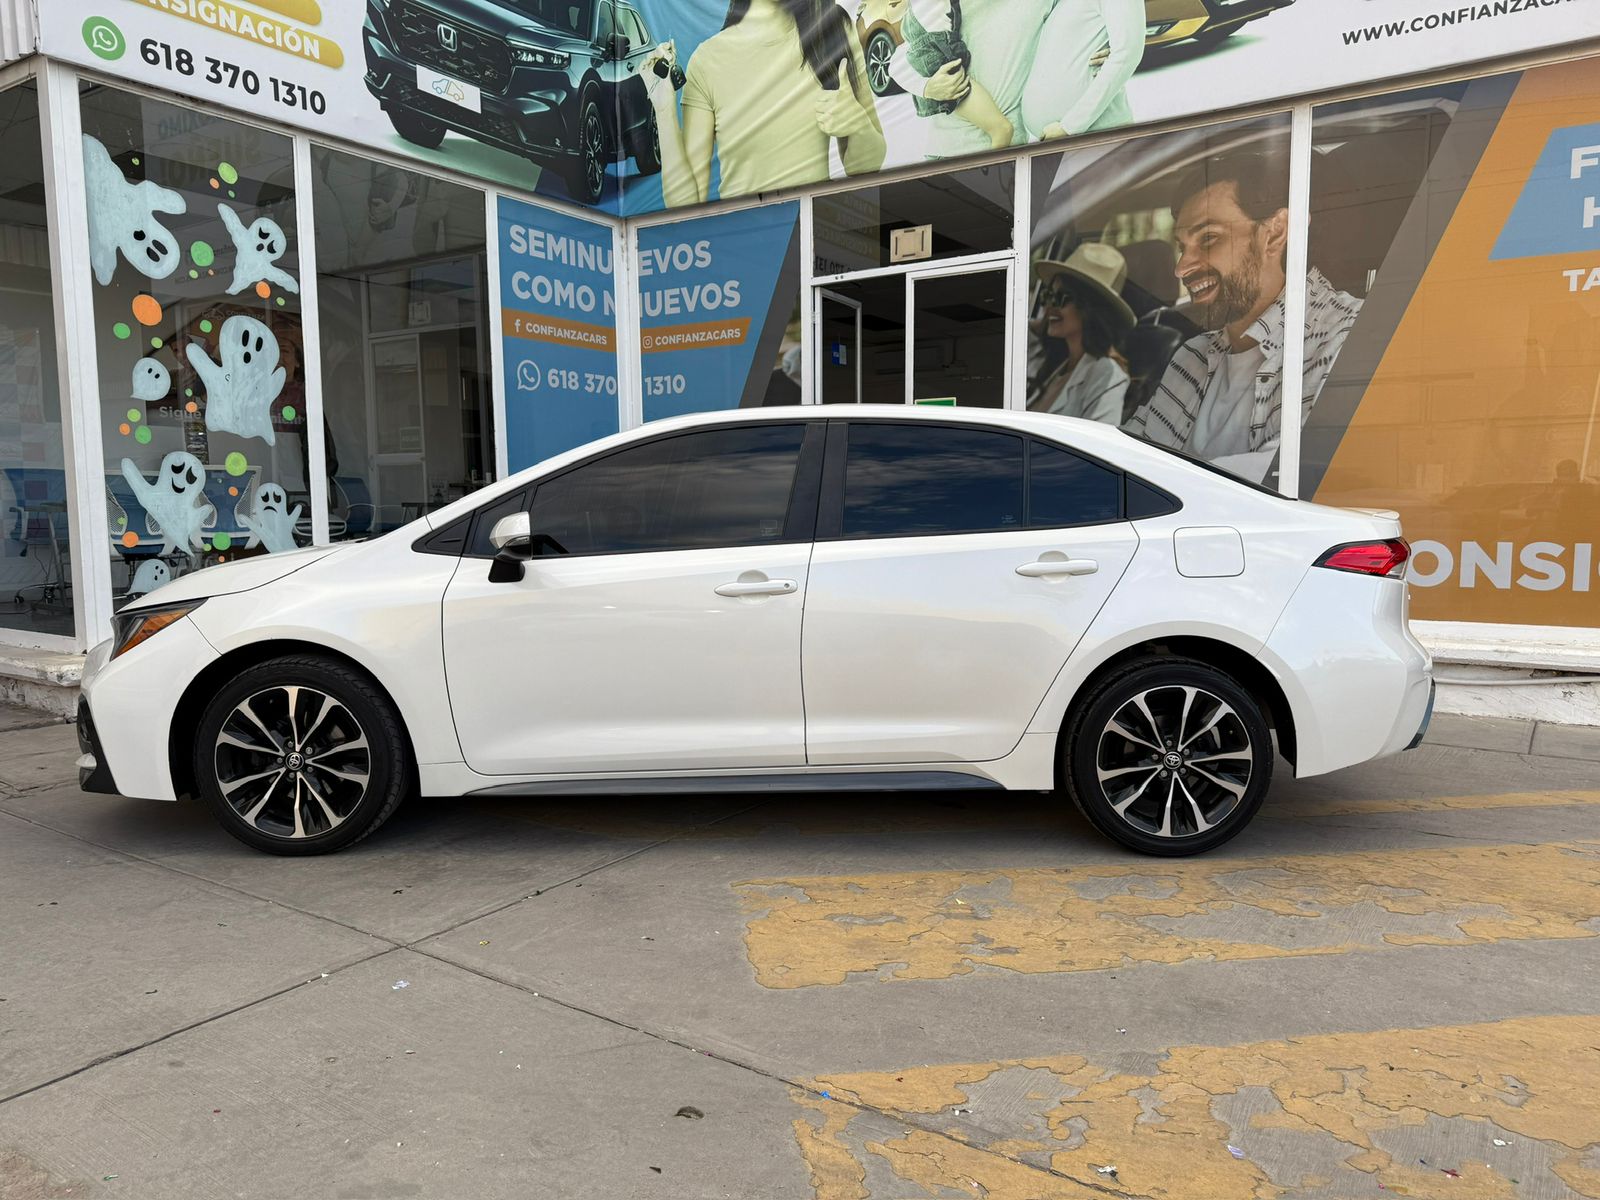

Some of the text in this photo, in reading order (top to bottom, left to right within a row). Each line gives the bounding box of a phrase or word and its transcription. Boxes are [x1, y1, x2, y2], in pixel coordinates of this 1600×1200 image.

[149, 0, 320, 59] SIGNACIÓN
[1342, 0, 1575, 45] WWW.CONFIANZA
[140, 38, 326, 115] 618 370 1310
[511, 270, 596, 312] COMO
[525, 322, 608, 345] CONFIANZACARS
[655, 328, 741, 346] CONFIANZACARS
[547, 368, 686, 396] 618 370 1310
[1405, 539, 1600, 592] ONSI
